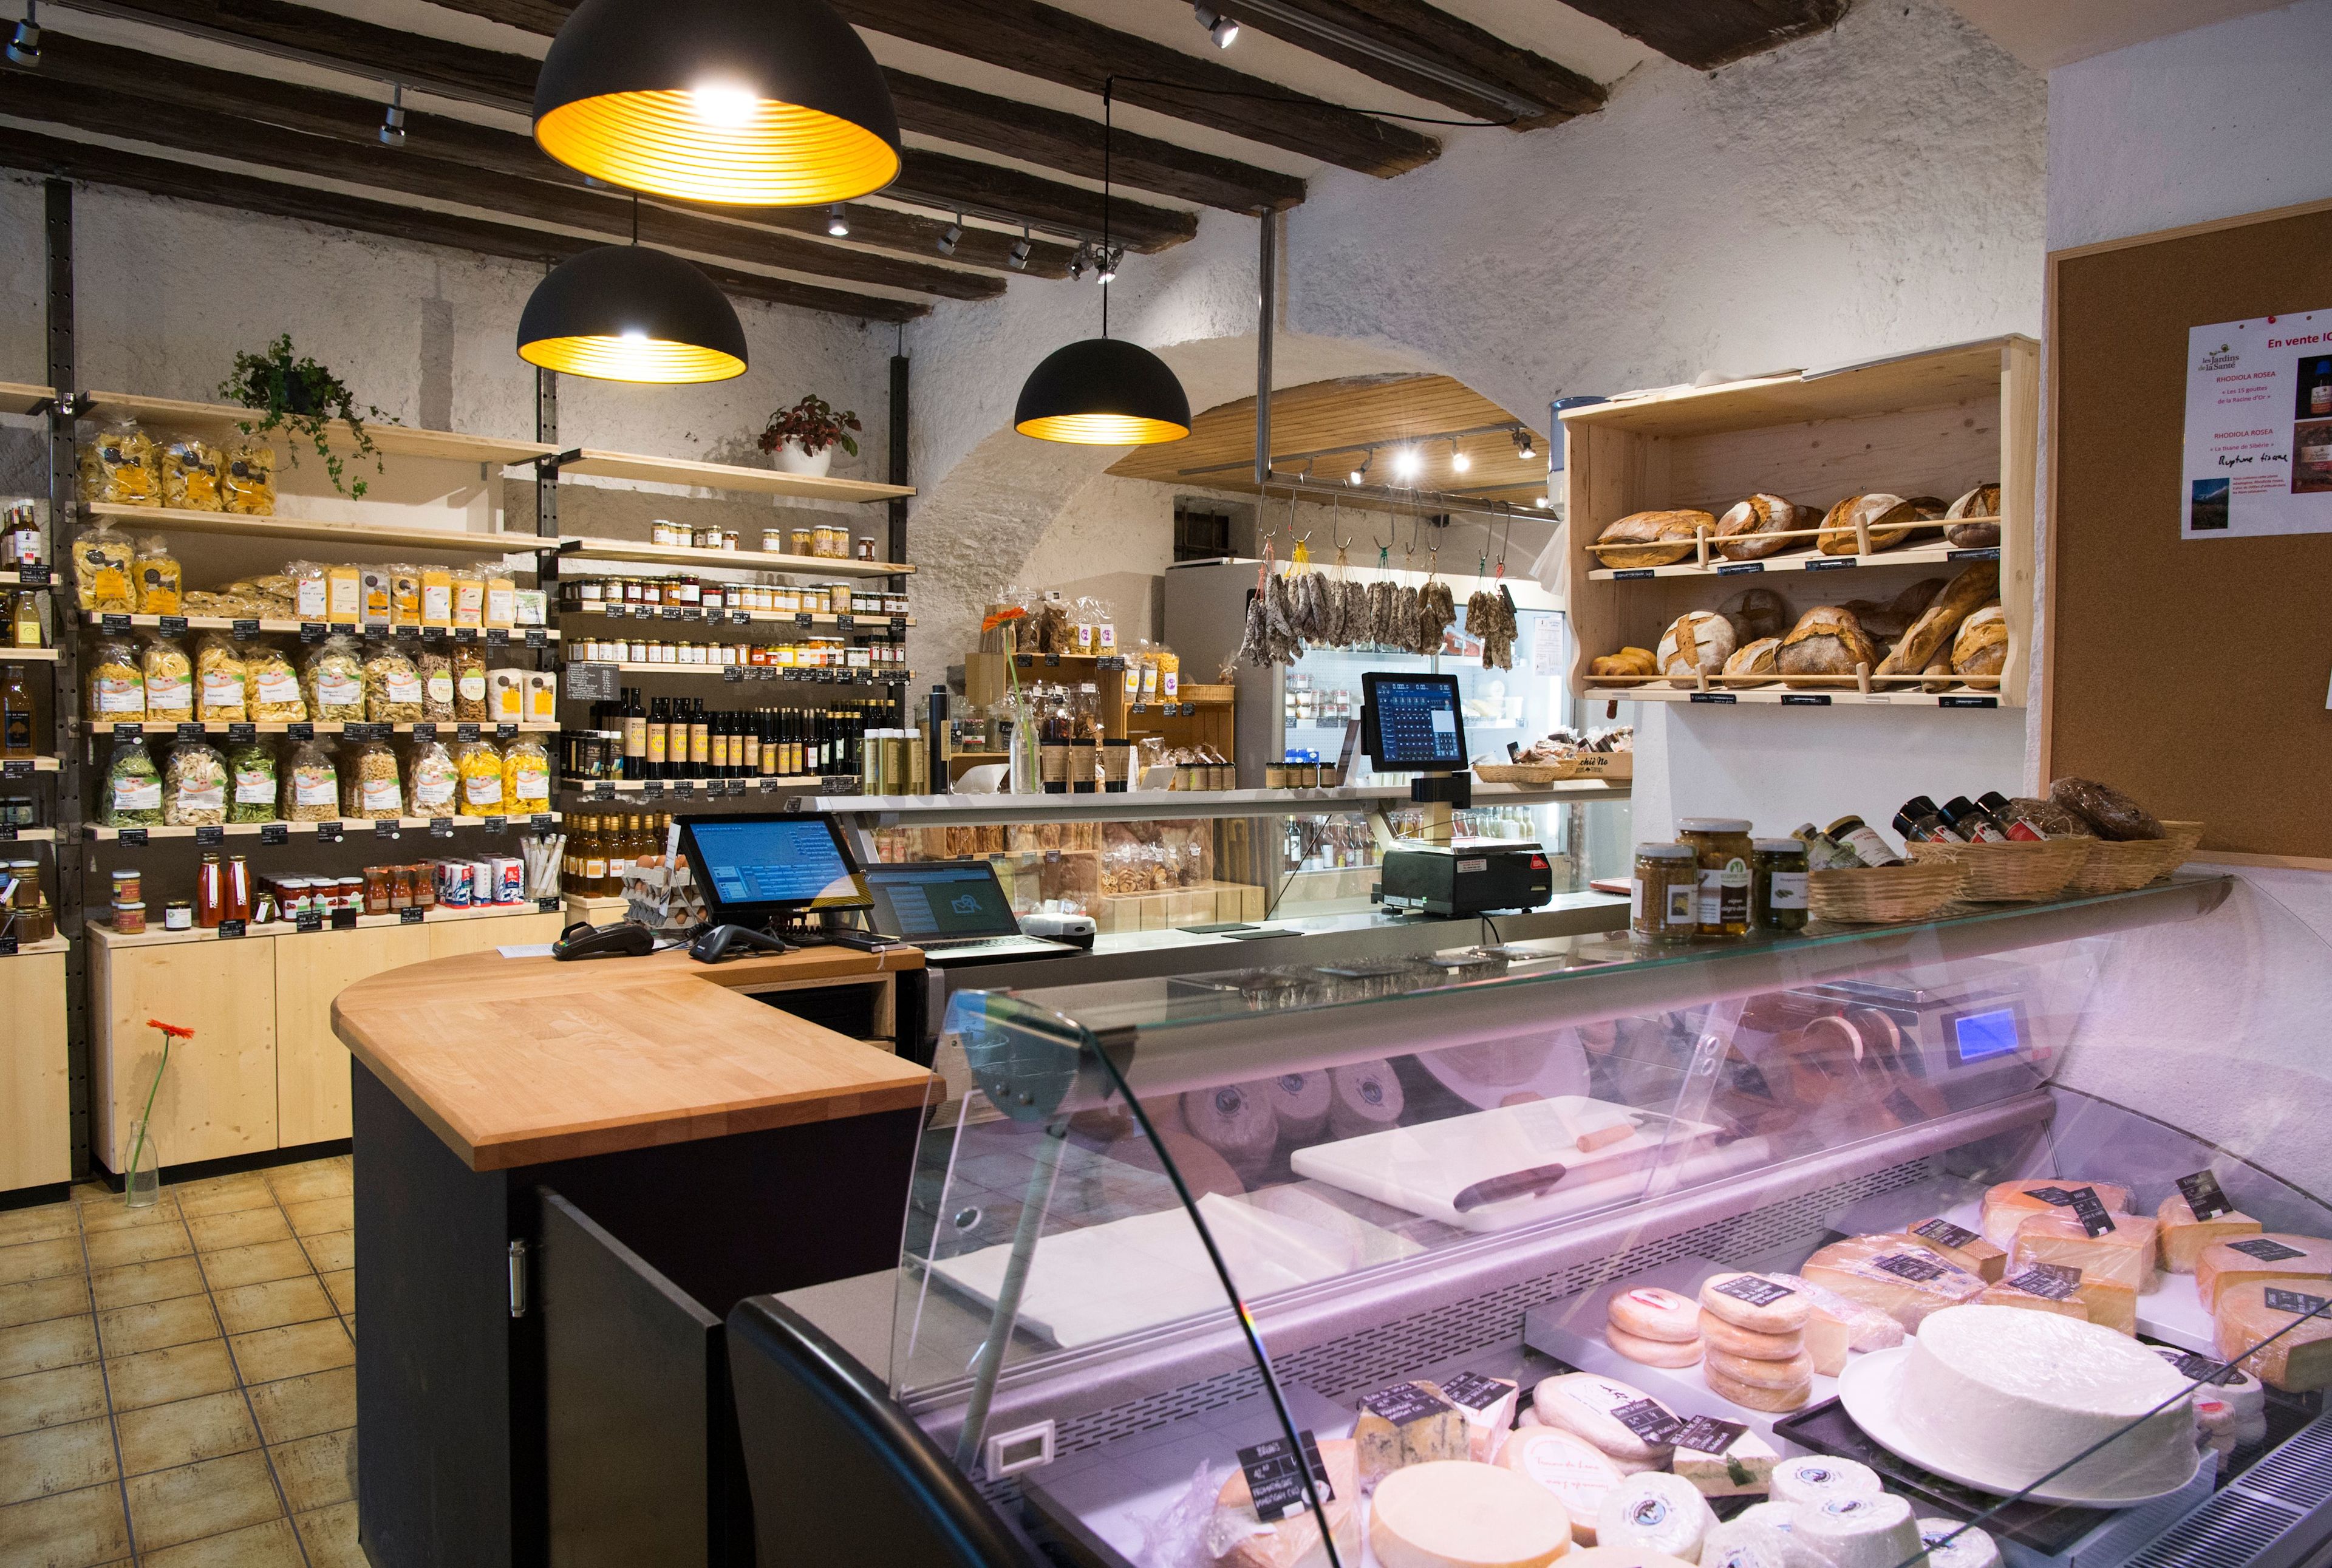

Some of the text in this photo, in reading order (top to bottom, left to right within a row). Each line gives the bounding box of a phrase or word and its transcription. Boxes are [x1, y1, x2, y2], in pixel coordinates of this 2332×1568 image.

[2268, 339, 2282, 348] En
[2285, 335, 2319, 346] vente
[2211, 355, 2239, 364] Jardins
[2214, 361, 2235, 370] Santé
[2217, 374, 2251, 383] RHODIOLA
[2260, 452, 2288, 462] tisane
